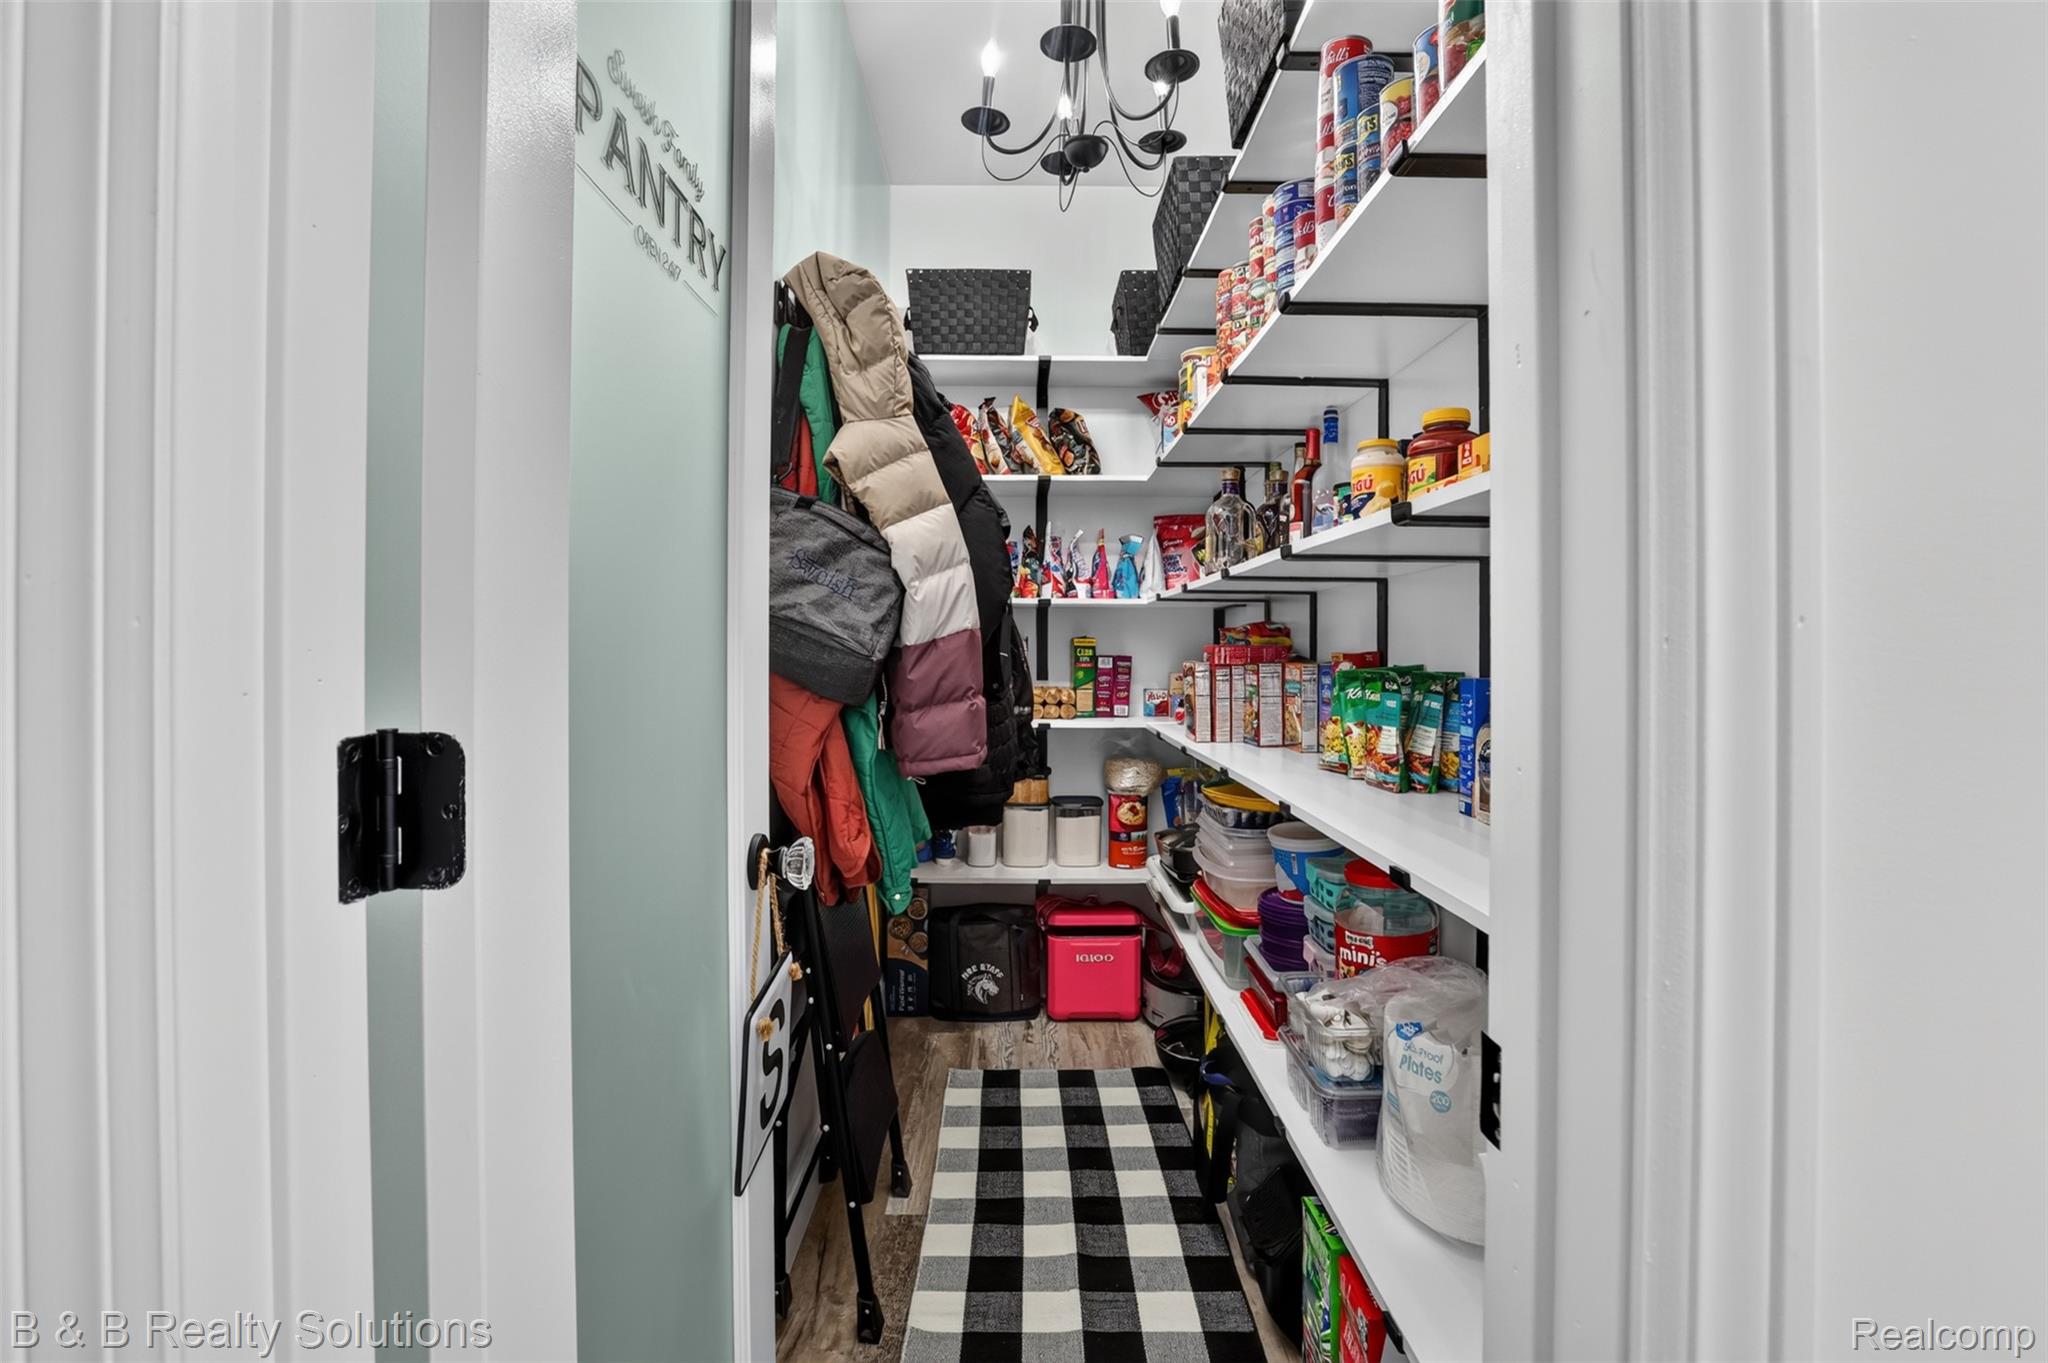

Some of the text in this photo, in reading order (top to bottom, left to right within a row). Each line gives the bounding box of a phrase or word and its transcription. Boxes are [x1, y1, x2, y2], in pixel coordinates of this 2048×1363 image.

[575, 53, 727, 292] PANTRY
[1075, 953, 1114, 963] IGLOO
[1399, 1054, 1442, 1084] Plates
